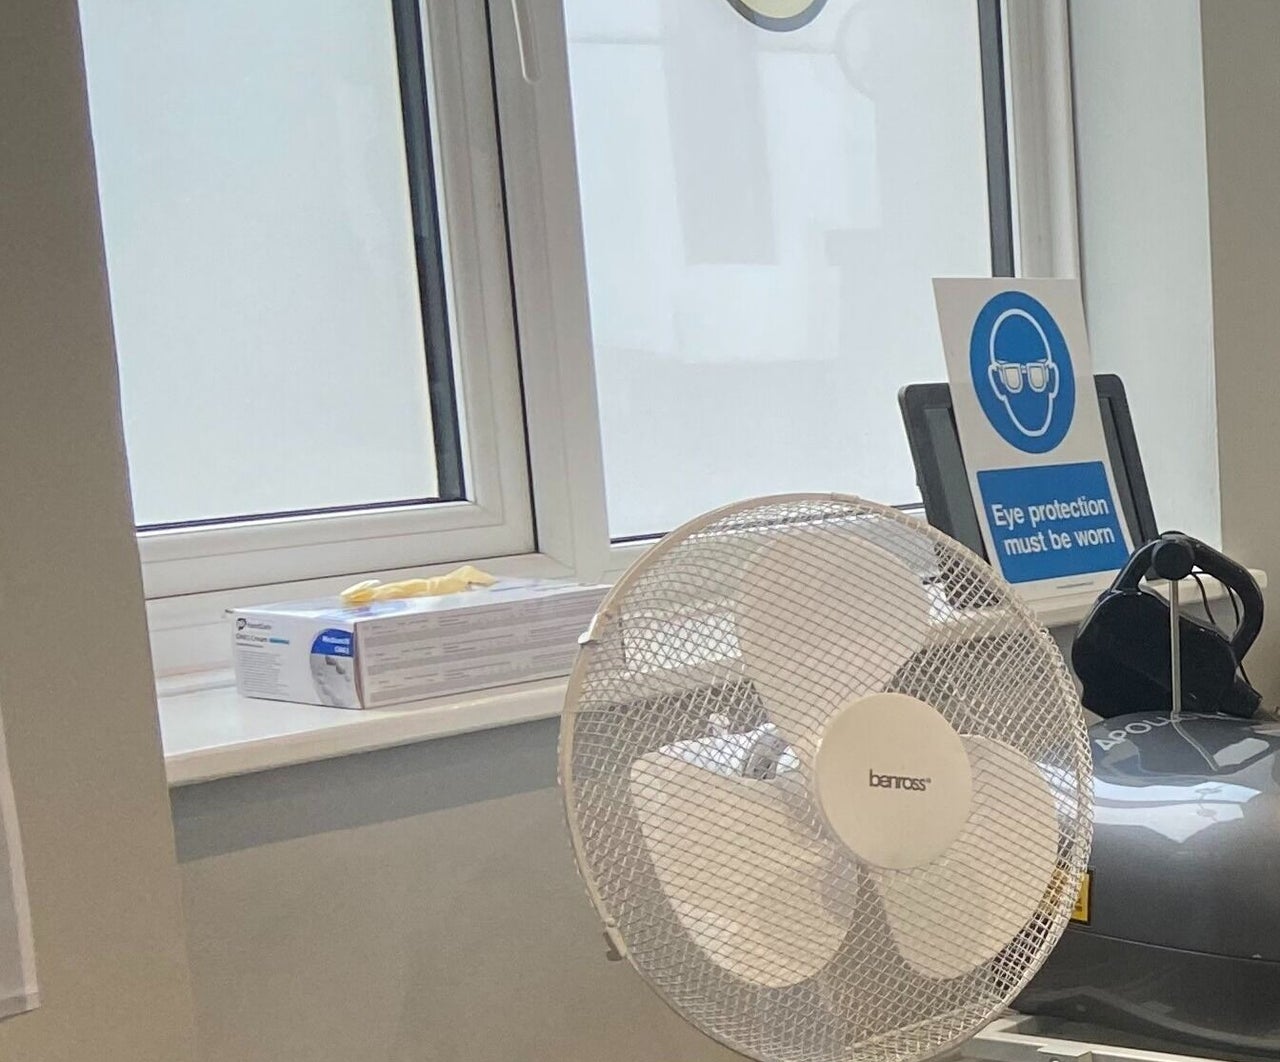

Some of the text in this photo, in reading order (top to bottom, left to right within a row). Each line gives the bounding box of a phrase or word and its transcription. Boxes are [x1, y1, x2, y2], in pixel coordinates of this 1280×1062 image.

[991, 496, 1109, 531] Eye protection
[1004, 527, 1115, 555] must be worn
[869, 769, 926, 791] benross
